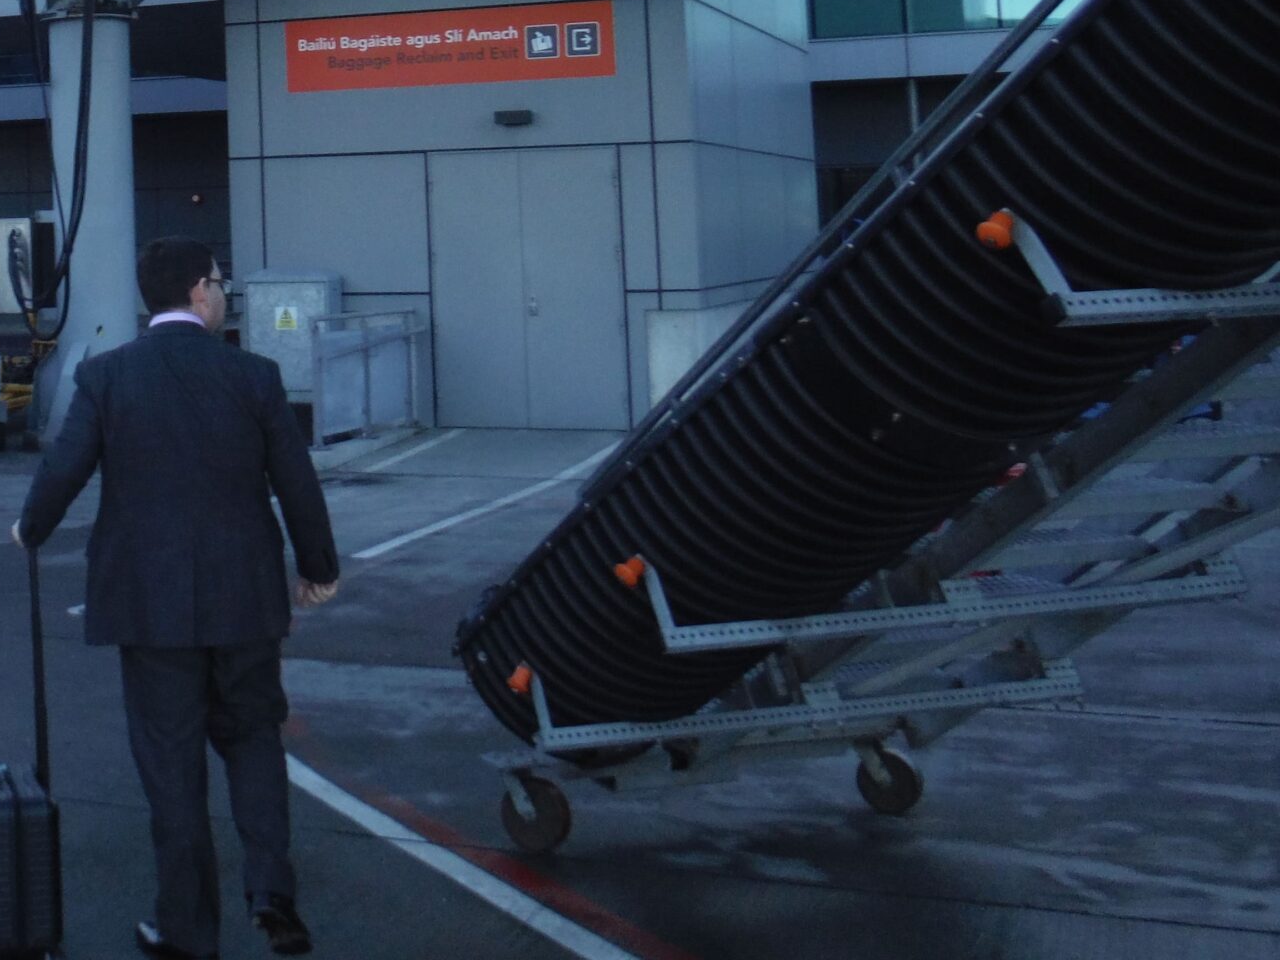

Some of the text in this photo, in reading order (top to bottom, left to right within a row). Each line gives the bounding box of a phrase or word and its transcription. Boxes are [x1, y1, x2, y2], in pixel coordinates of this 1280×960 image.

[406, 34, 441, 48] agus
[467, 26, 518, 41] Amach
[328, 46, 519, 71] Baggage Reclaim and Exit
